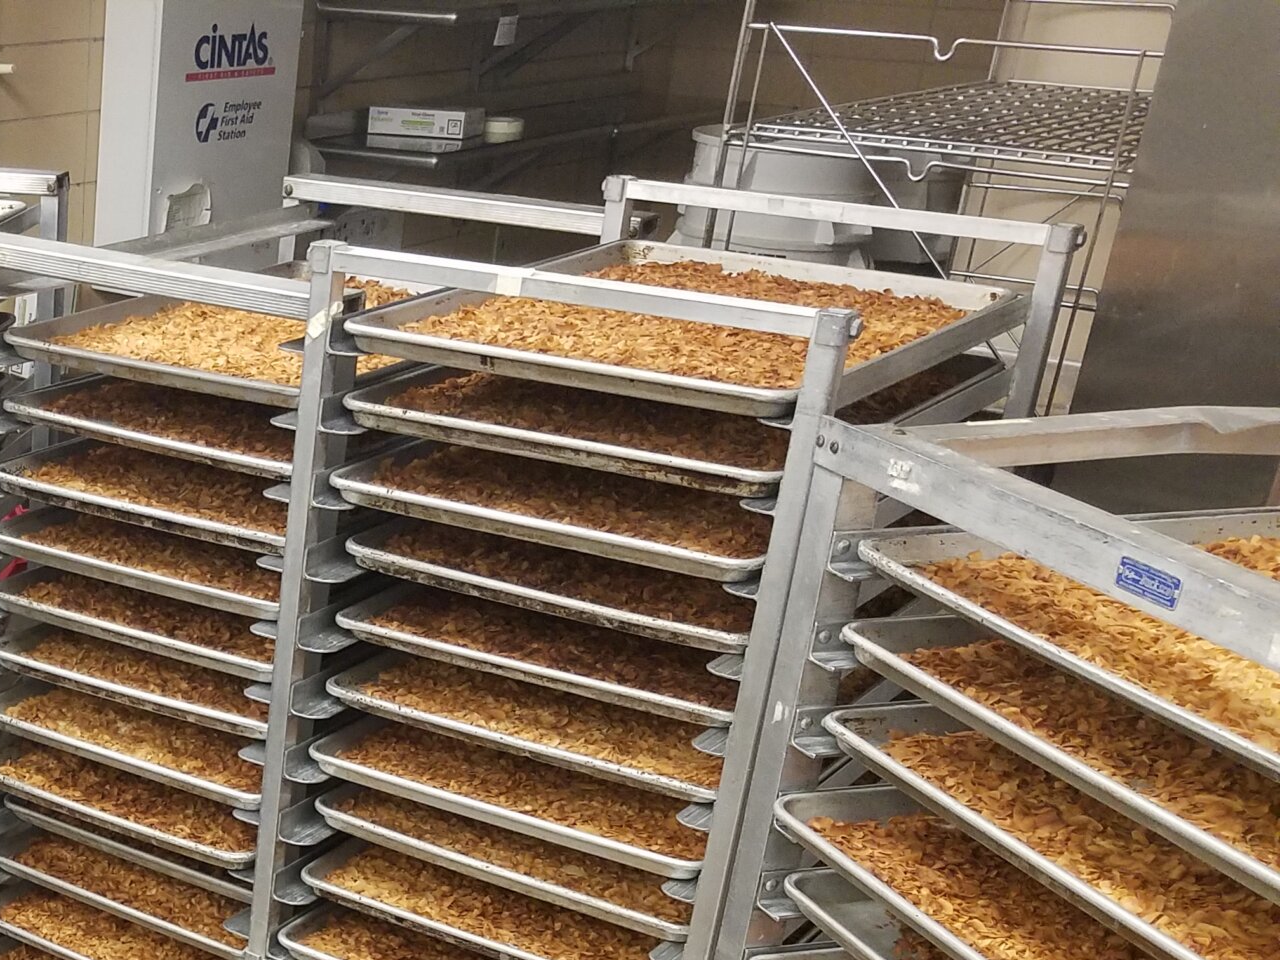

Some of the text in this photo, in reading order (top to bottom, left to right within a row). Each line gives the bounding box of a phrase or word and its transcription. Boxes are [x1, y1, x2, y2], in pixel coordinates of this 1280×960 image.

[223, 100, 262, 114] Employee
[220, 112, 254, 127] First Aid
[217, 128, 246, 141] Station
